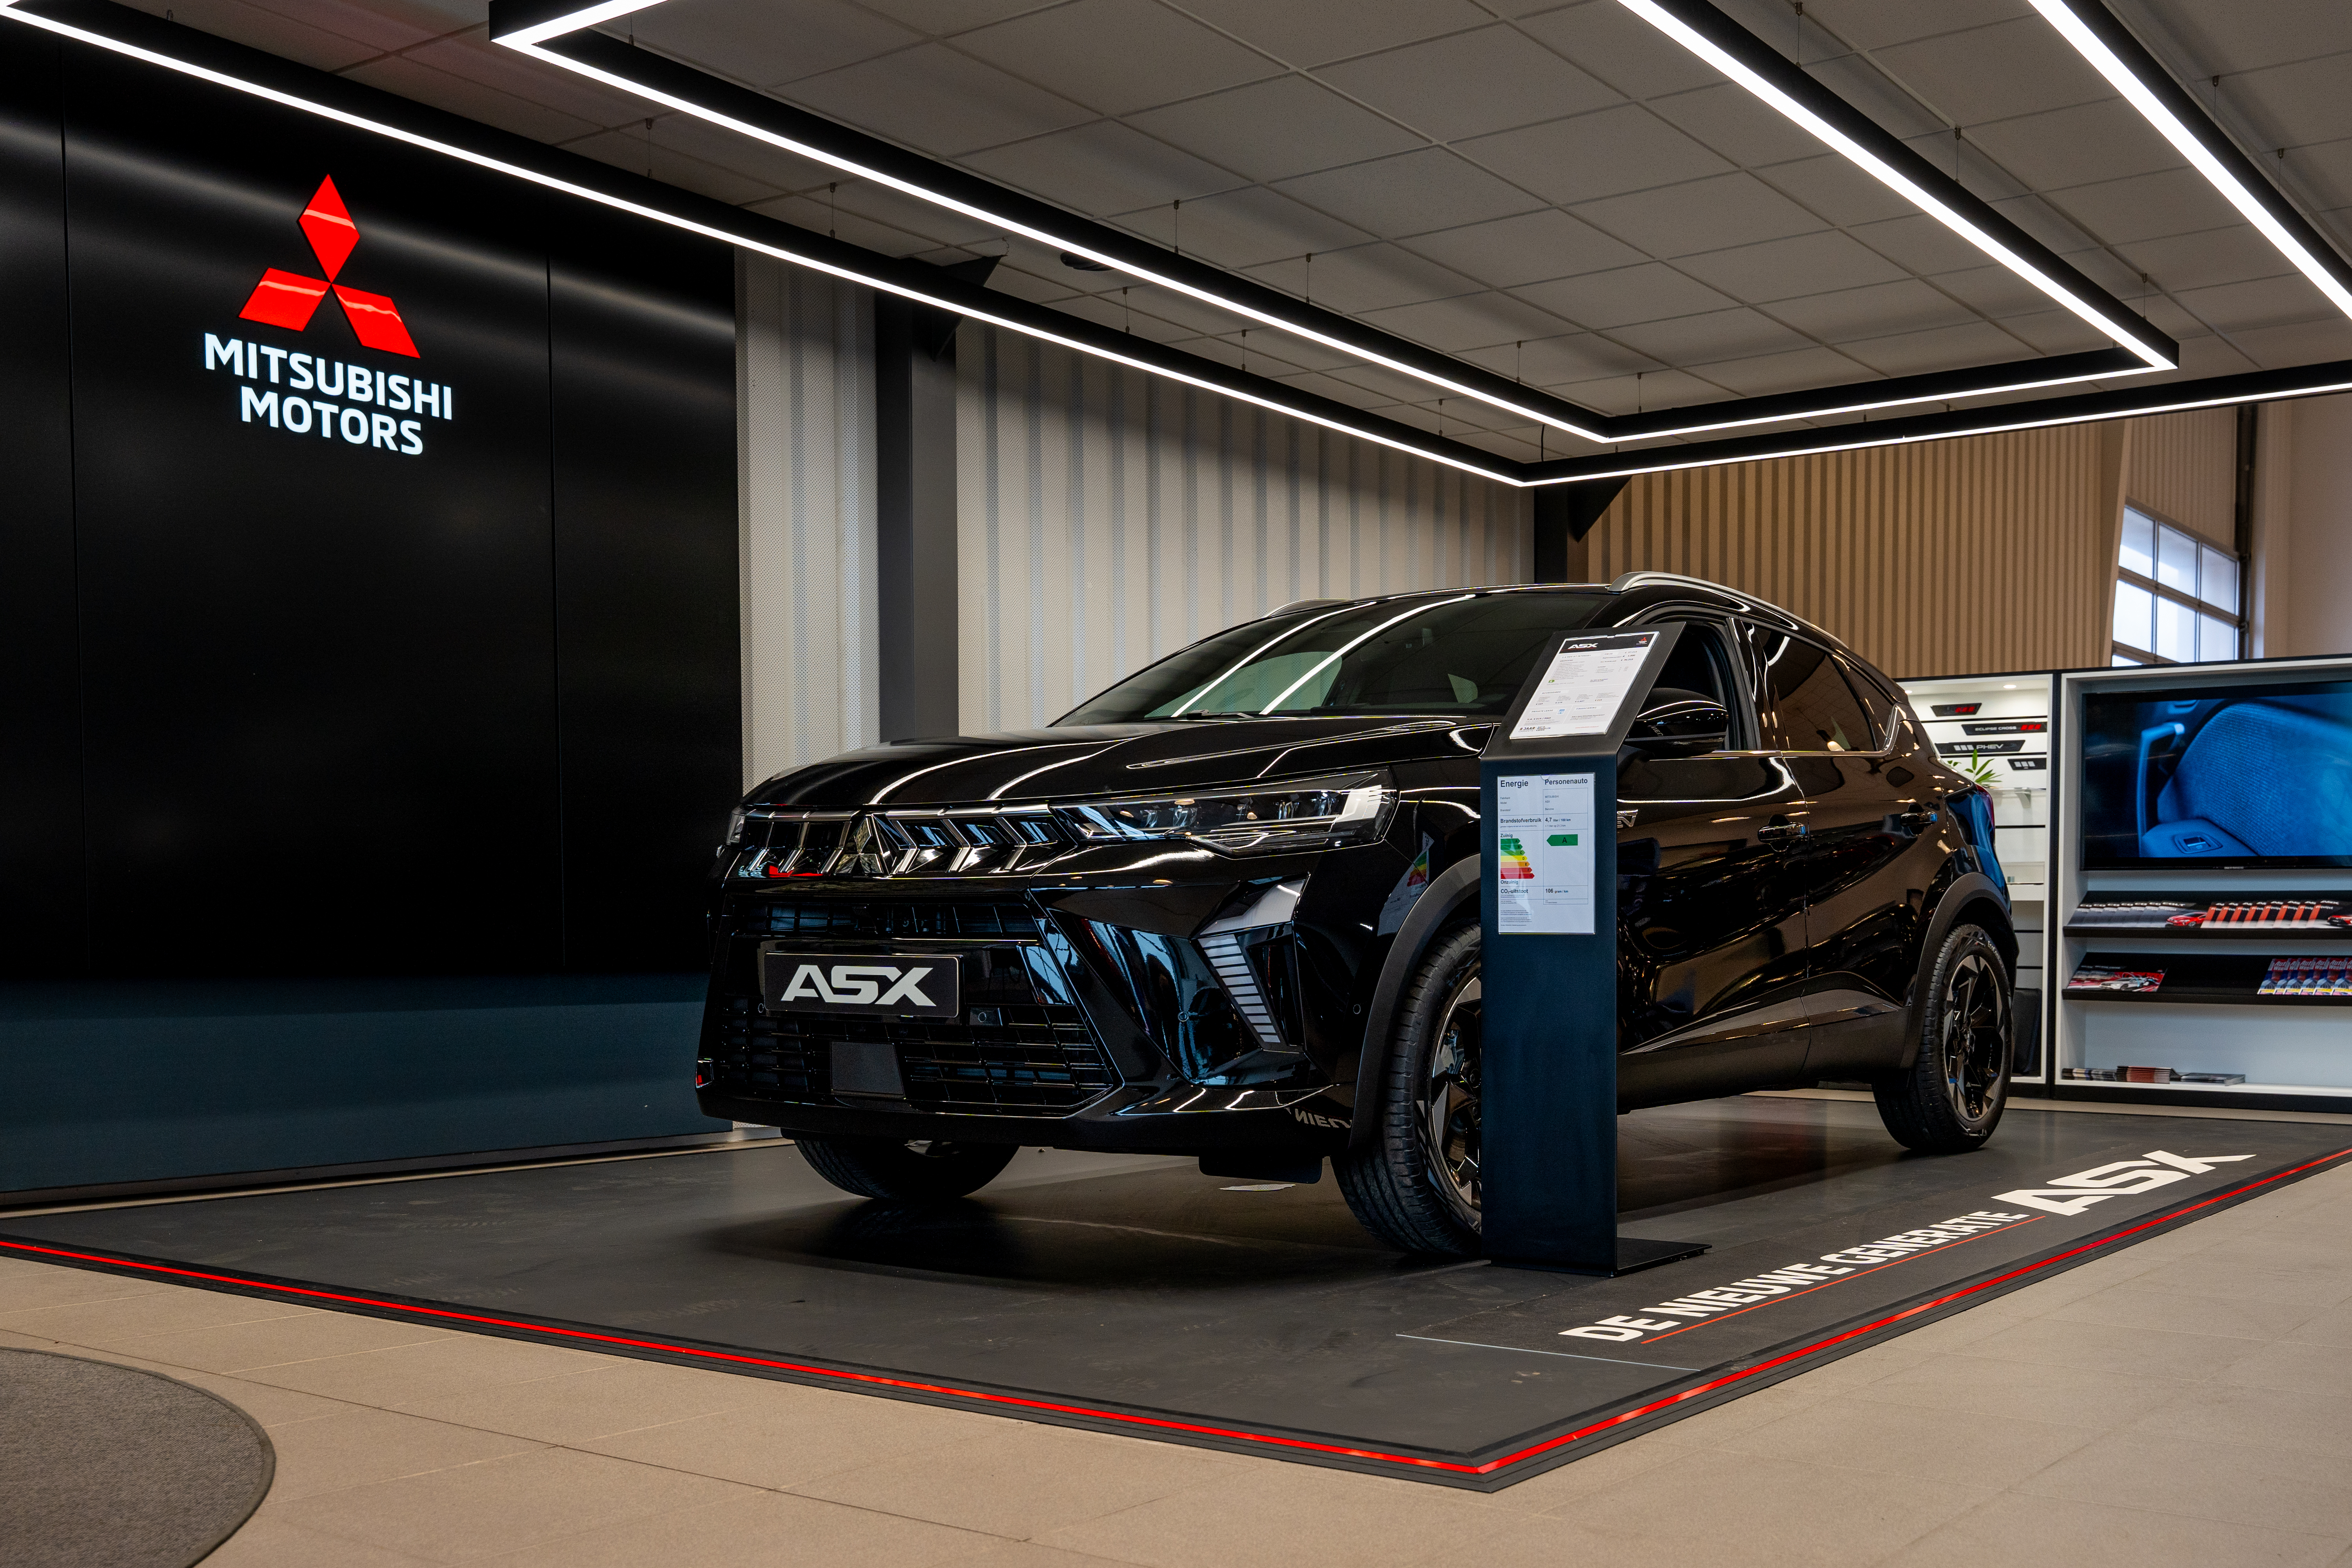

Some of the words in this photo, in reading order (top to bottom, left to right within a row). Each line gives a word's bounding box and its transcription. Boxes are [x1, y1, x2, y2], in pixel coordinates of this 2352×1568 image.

[205, 333, 452, 420] MITSUBISHI
[241, 386, 423, 455] MOTORS
[1500, 779, 1529, 789] Energie
[781, 965, 936, 1007] ASX
[1558, 1315, 1682, 1341] DE
[1639, 1263, 1856, 1317] NIEUWE
[1820, 1211, 2030, 1264] GENERATIE
[1991, 1150, 2257, 1216] ASX
